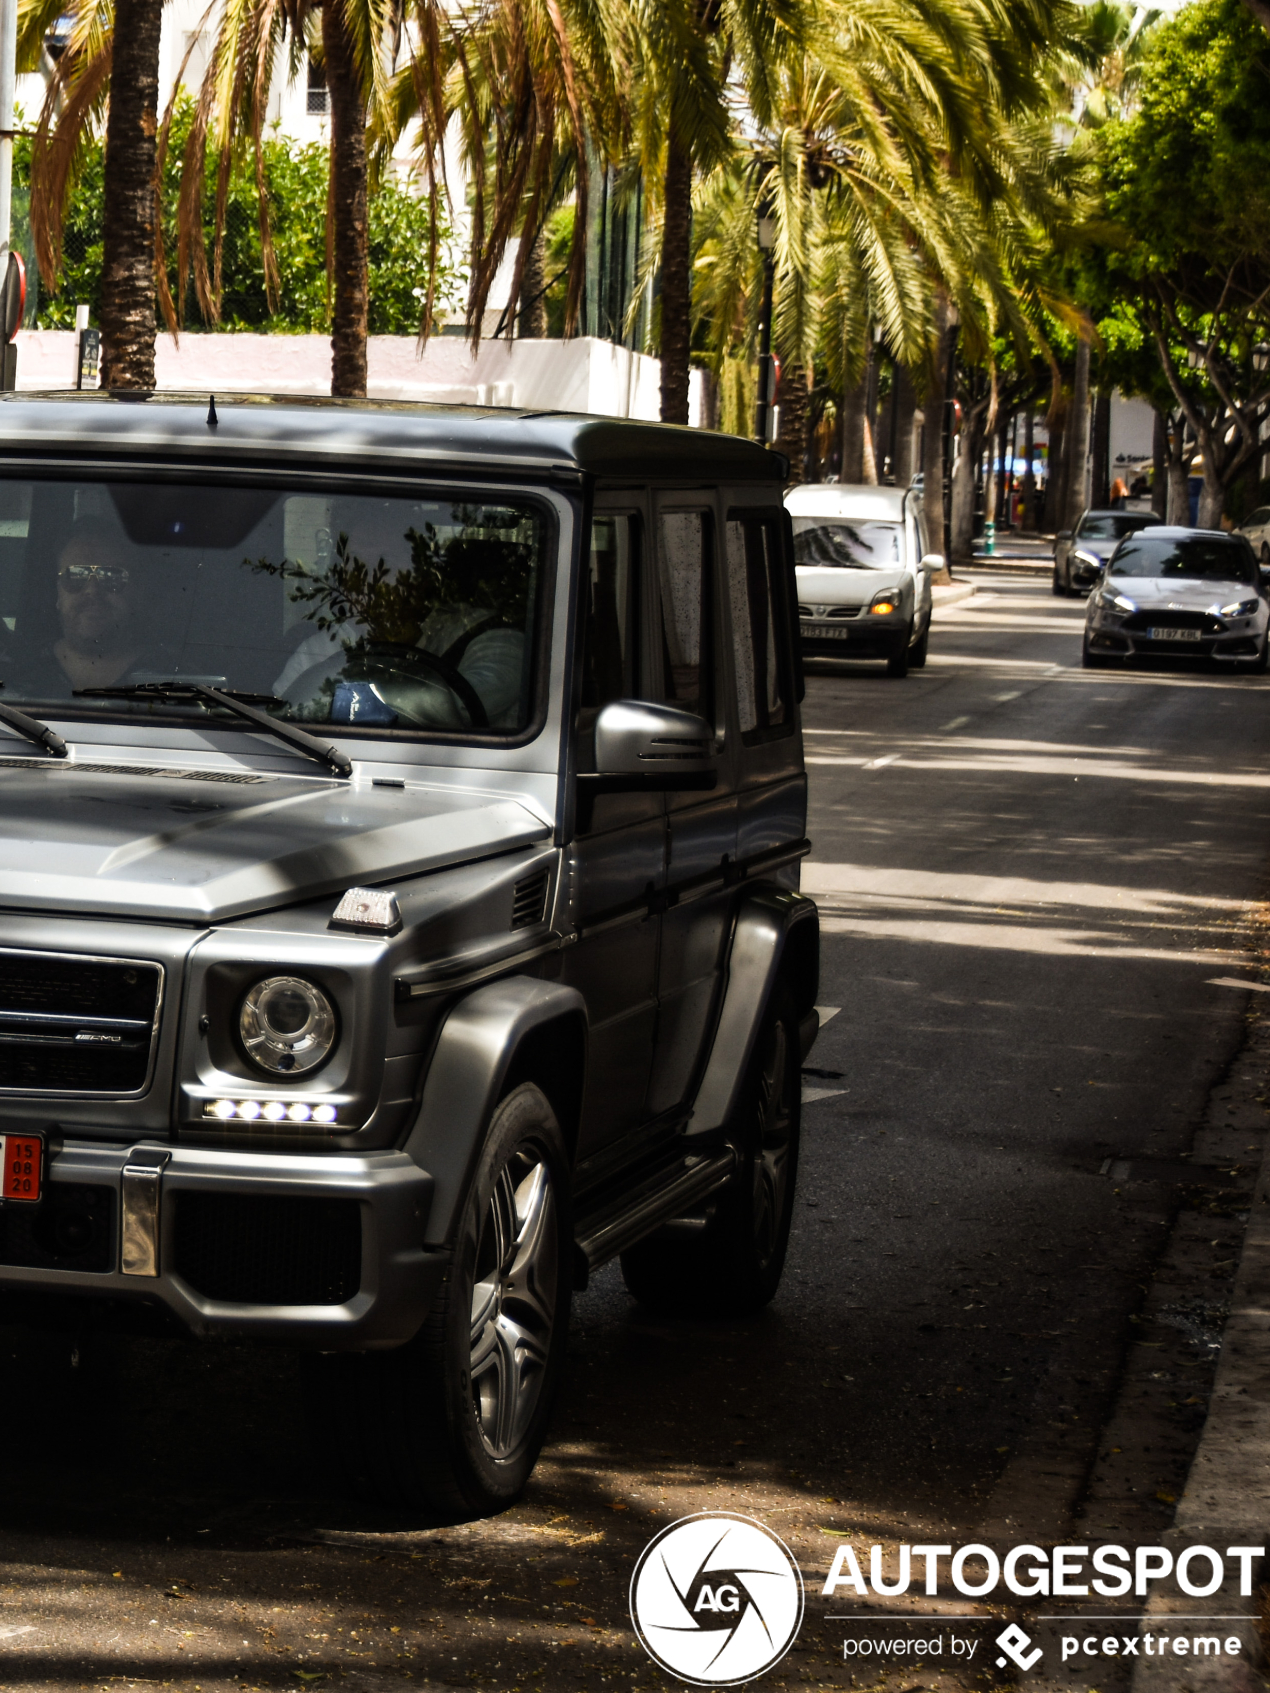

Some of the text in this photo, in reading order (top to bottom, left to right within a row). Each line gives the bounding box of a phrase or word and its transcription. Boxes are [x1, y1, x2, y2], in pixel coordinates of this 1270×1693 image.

[16, 1144, 32, 1158] 15
[13, 1160, 32, 1174] 08
[12, 1178, 31, 1192] 20
